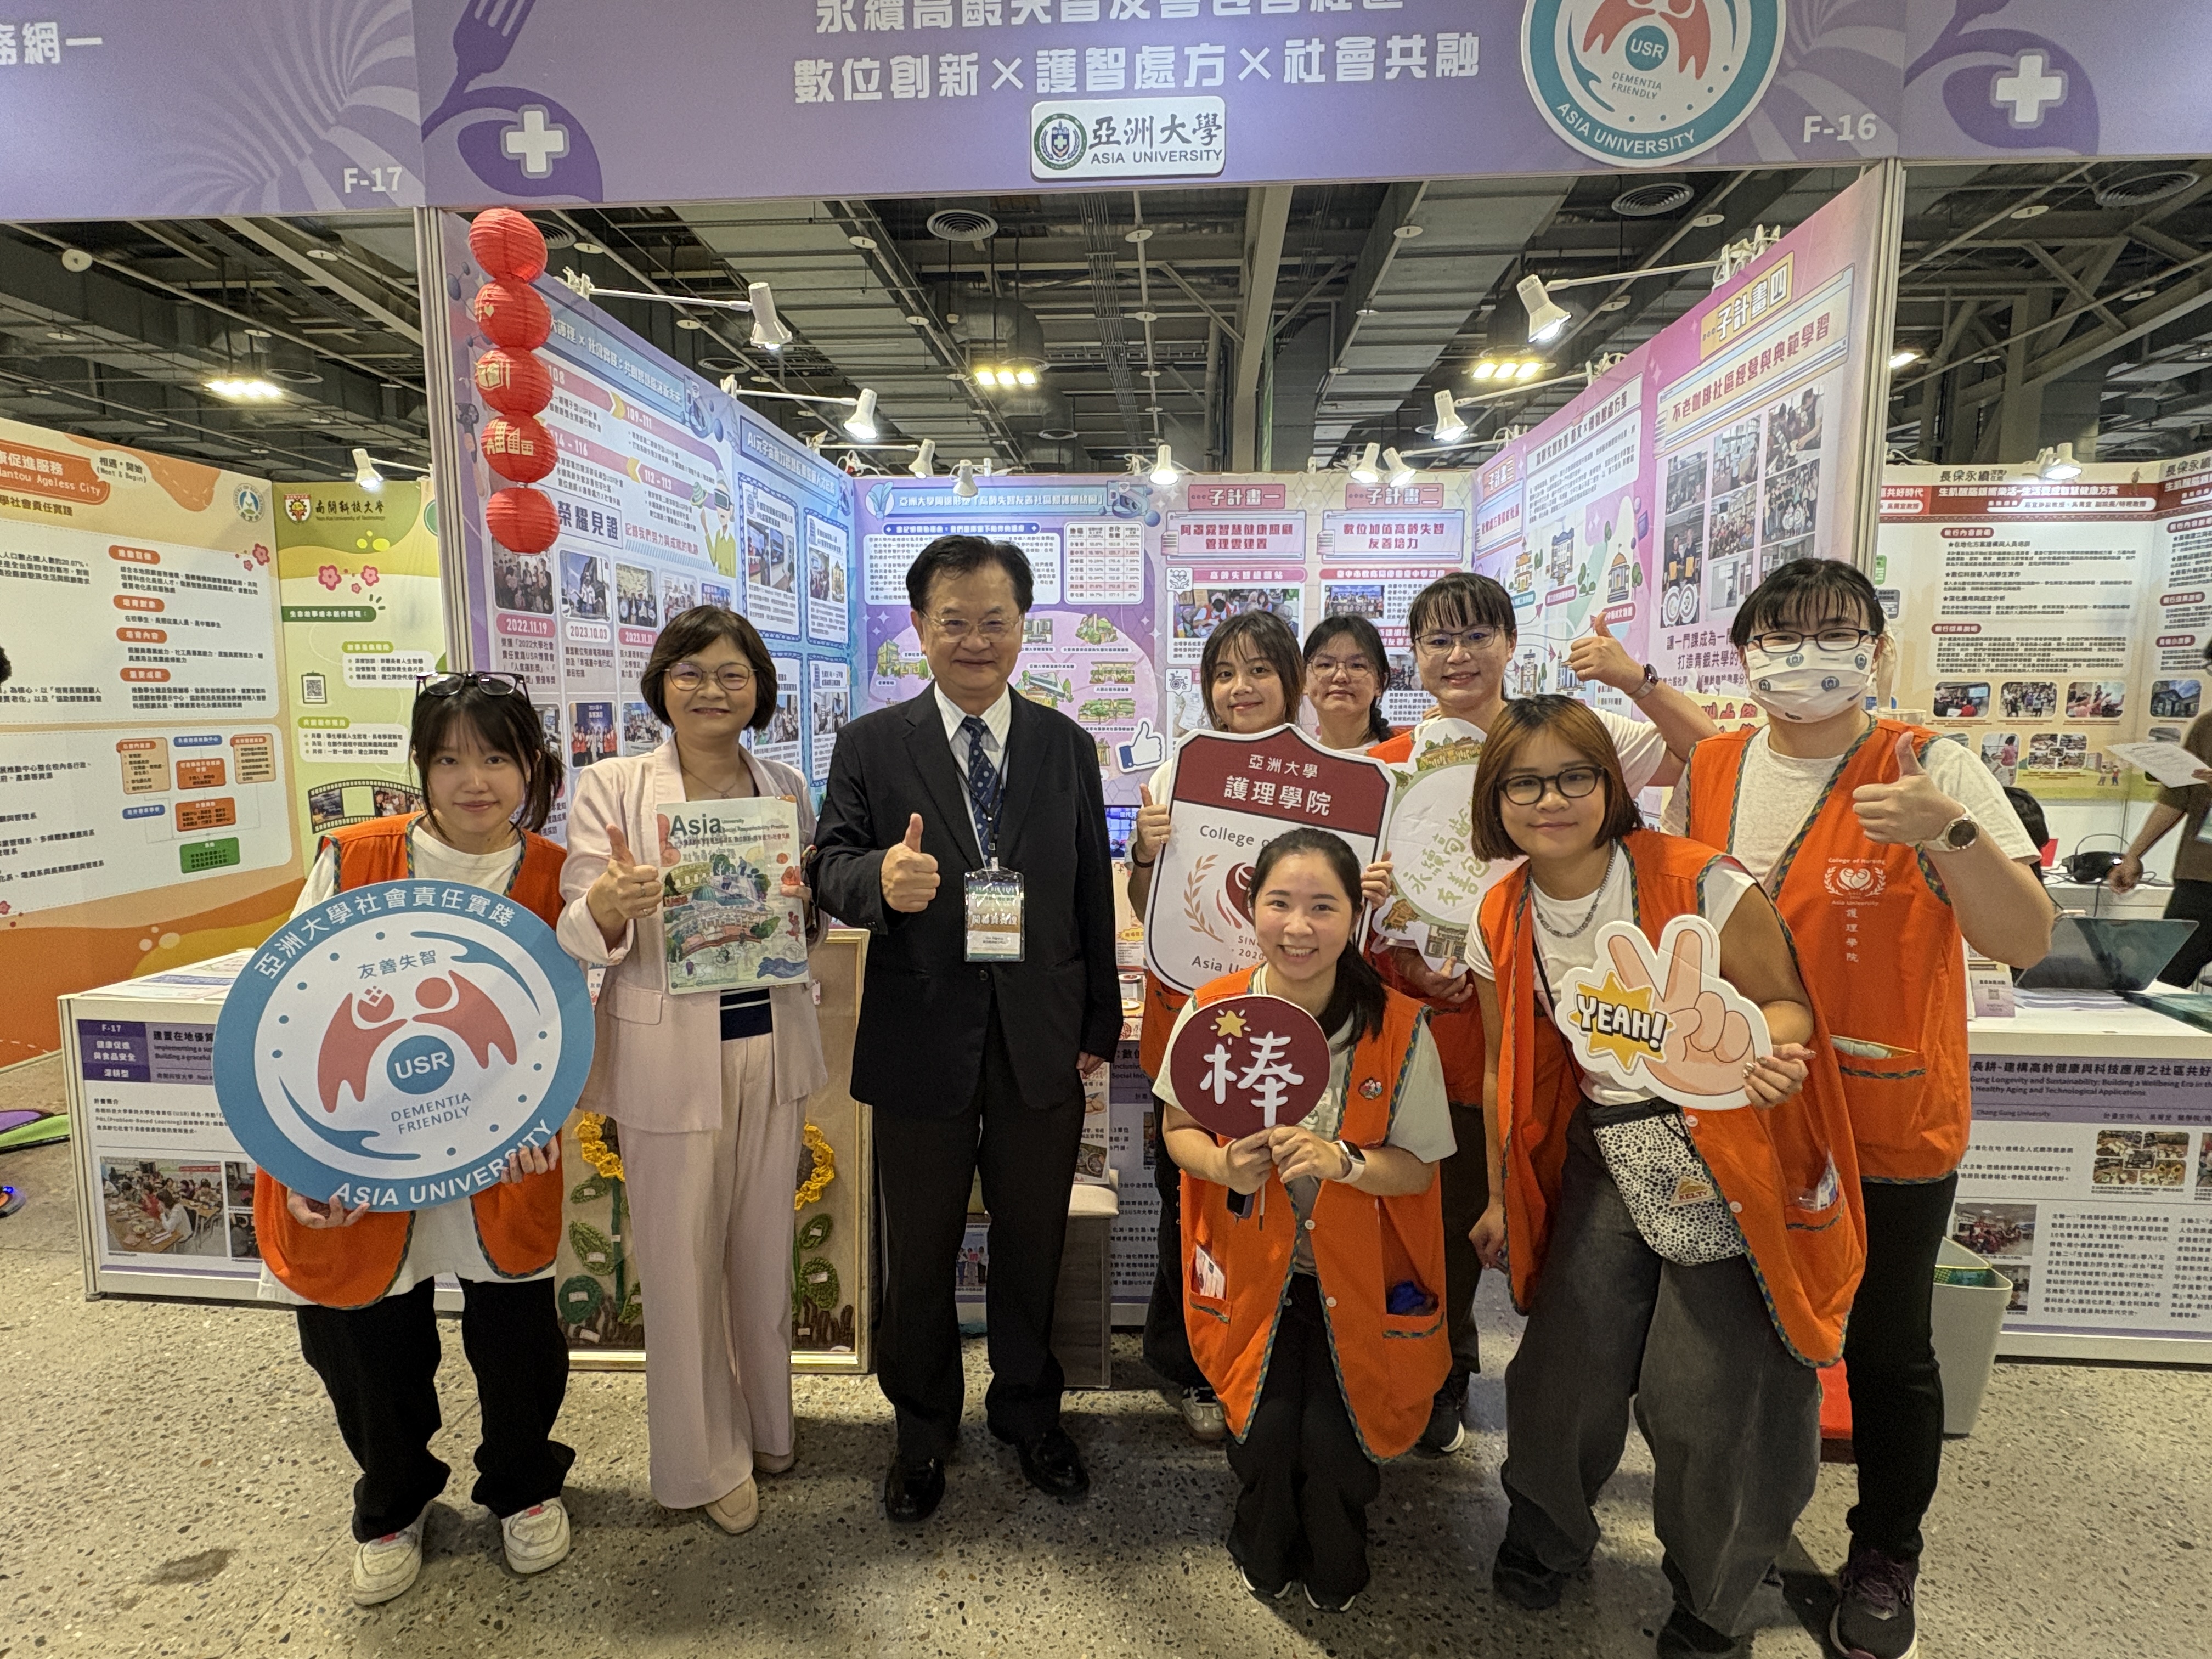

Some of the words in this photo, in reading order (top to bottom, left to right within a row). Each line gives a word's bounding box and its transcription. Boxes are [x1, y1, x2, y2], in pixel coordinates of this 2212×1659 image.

[1630, 38, 1665, 59] USR
[1611, 82, 1658, 100] FRIENDLY
[1612, 71, 1662, 91] DEMENTIA
[1089, 113, 1222, 150] 亞洲大學
[1556, 102, 1590, 136] ASIA
[1594, 129, 1696, 154] UNIVERSITY
[1803, 113, 1877, 143] F-16
[1091, 153, 1125, 164] ASIA
[1133, 149, 1222, 162] UNIVERSITY
[344, 167, 403, 194] F-17
[1717, 263, 1788, 341] 子計畫四
[627, 407, 652, 429] 109-111
[0, 469, 31, 482] antou
[37, 474, 75, 490] Ageless
[80, 482, 101, 496] City
[1208, 488, 1280, 505] 子計畫一
[1367, 487, 1440, 505] 子計畫二
[557, 500, 619, 540] 榮耀見證
[1344, 523, 1444, 535] 數位加值高齡失智
[1369, 538, 1418, 549] 友善培力
[506, 618, 547, 634] 2022.11.19
[571, 626, 607, 640] 2023.10.03
[625, 631, 653, 644] 2023.11.11
[1248, 754, 1318, 778] 亞洲大學
[1224, 776, 1332, 816] 護理學院
[670, 813, 721, 836] Asia
[1200, 825, 1254, 846] College
[1262, 839, 1271, 848] o
[254, 887, 516, 980] 亞洲大學社會責任實踐
[357, 949, 437, 979] 友善失智
[1192, 955, 1222, 972] Asia
[102, 1024, 122, 1032] F-17
[1576, 994, 1667, 1052] YEAH!
[394, 1051, 450, 1080] USR
[1200, 1031, 1304, 1127] 棒
[1991, 1076, 2027, 1086] Longevity
[2102, 1079, 2133, 1087] Building
[1976, 1086, 2005, 1095] Healthy
[2006, 1087, 2028, 1096] Aging
[390, 1092, 471, 1122] DEMENTIA
[397, 1107, 470, 1135] FRIENDLY
[334, 1183, 399, 1206] ASIA
[409, 1120, 552, 1204] UNIVERSITY
